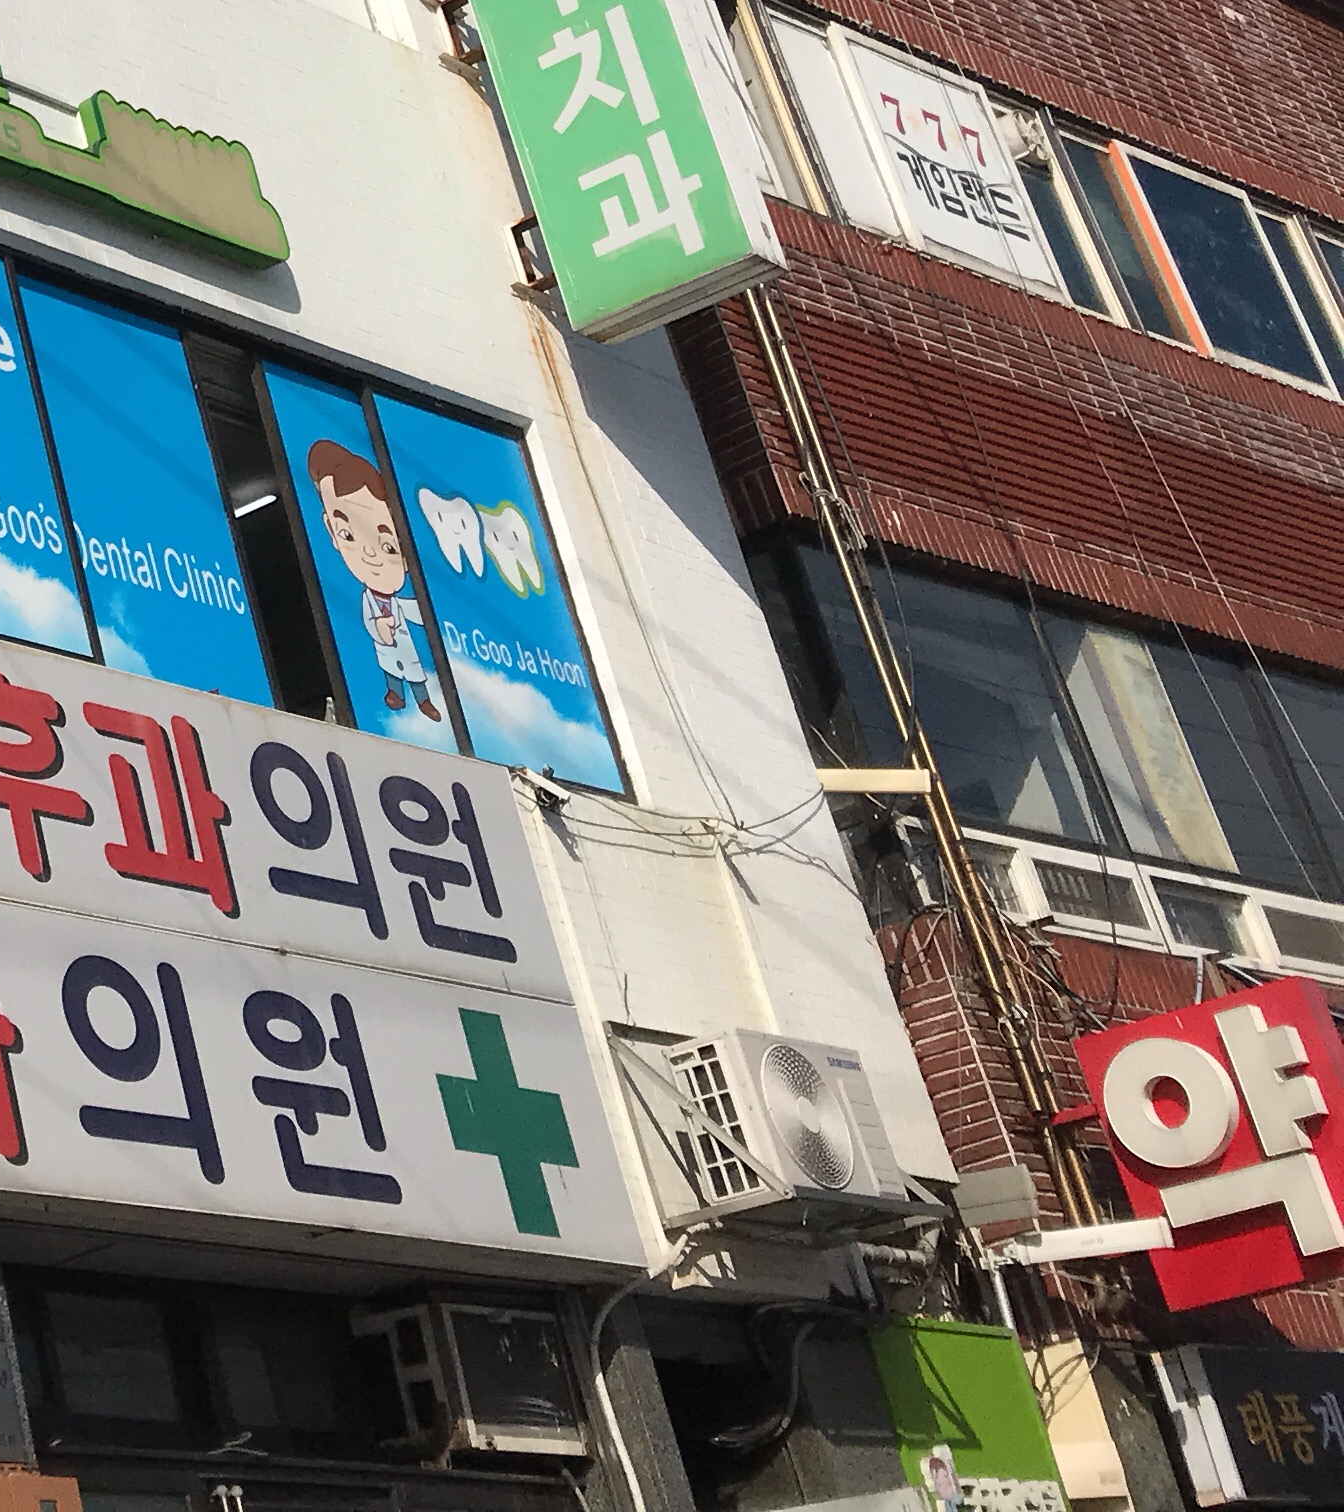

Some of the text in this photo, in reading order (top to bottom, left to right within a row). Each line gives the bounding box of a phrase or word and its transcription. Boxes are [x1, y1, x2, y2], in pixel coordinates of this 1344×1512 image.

[164, 547, 245, 616] Clinic
[515, 641, 539, 676] Ja
[539, 646, 586, 688] Hoon
[1103, 1003, 1344, 1258] 약
